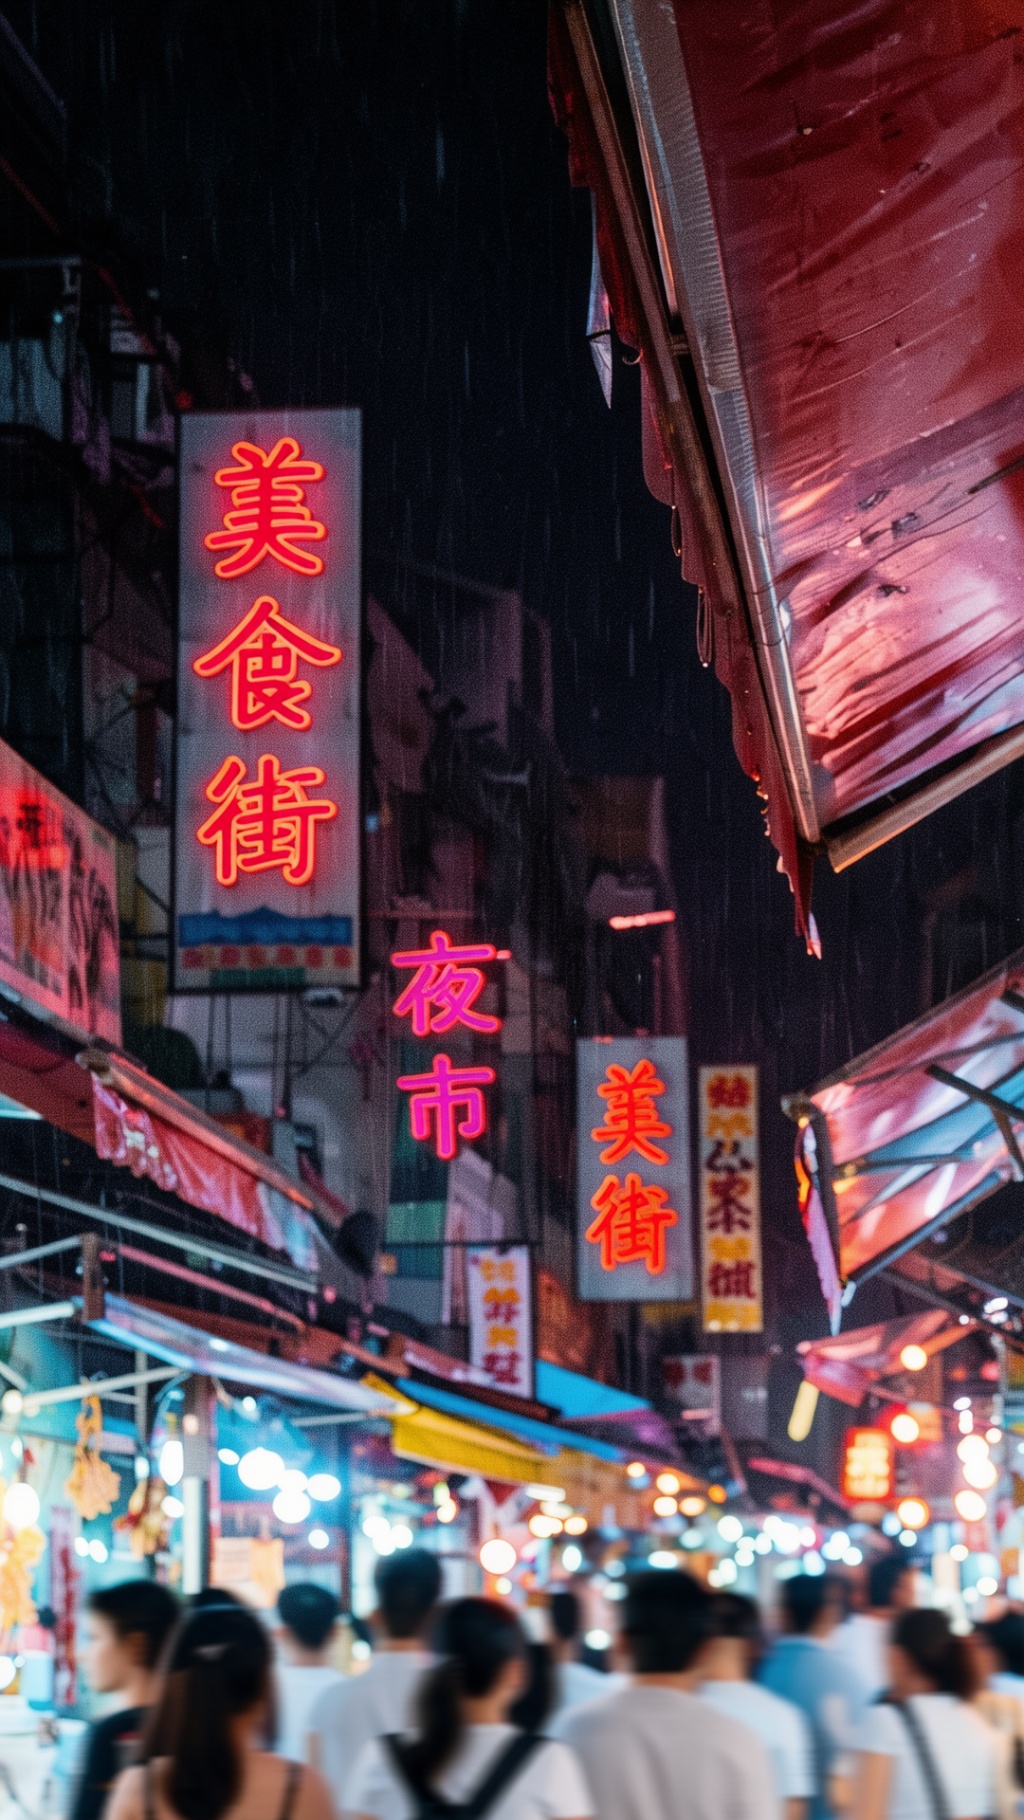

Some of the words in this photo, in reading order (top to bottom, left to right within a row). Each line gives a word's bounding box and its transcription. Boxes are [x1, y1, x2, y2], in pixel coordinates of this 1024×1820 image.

[193, 436, 342, 887] 美食街
[390, 930, 502, 1160] 夜市
[585, 1058, 678, 1276] 美街
